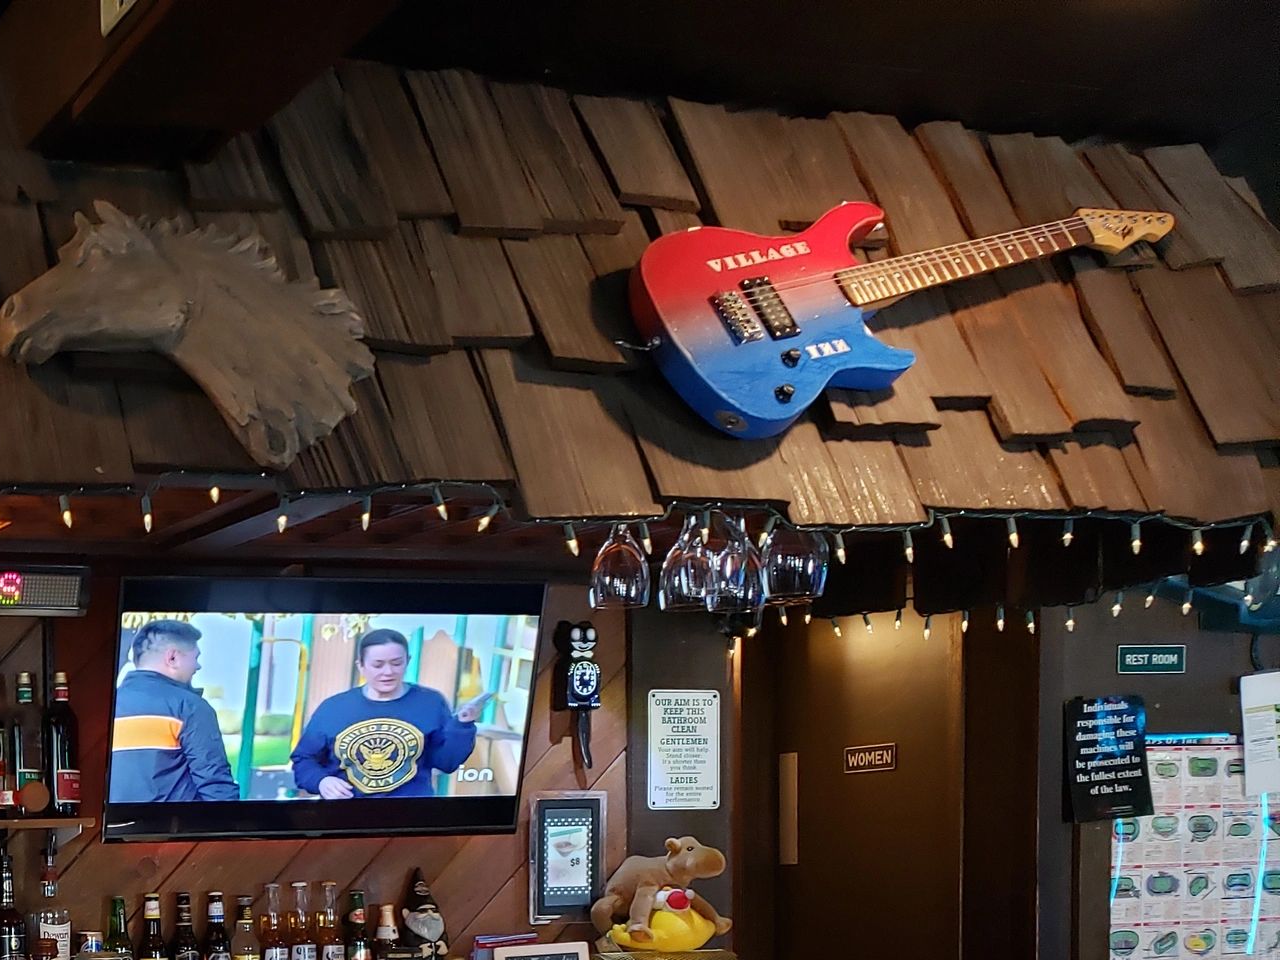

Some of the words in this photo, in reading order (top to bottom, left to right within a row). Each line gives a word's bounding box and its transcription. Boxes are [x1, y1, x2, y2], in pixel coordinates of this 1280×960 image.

[706, 241, 811, 272] VILLAGE
[805, 339, 851, 359] INN
[1125, 653, 1149, 665] REST
[1152, 653, 1178, 665] ROOM
[1083, 701, 1128, 713] Individuals
[1077, 716, 1121, 728] responsible
[1122, 715, 1135, 723] for
[340, 725, 376, 750] UNITED
[381, 724, 418, 747] STATES
[1076, 730, 1115, 741] damaging
[1116, 729, 1137, 737] these
[1080, 745, 1118, 754] machines
[1119, 741, 1134, 751] will
[848, 750, 892, 767] WOMEN
[1076, 760, 1086, 769] be
[1087, 755, 1130, 770] prosecuted
[457, 765, 493, 782] ion
[1076, 773, 1090, 782] the
[1091, 771, 1116, 781] fullest
[1117, 769, 1142, 779] extent
[361, 775, 394, 787] NAVY
[1090, 786, 1099, 795] of
[1100, 785, 1113, 794] the
[1115, 784, 1132, 792] law.
[570, 857, 580, 867] $8
